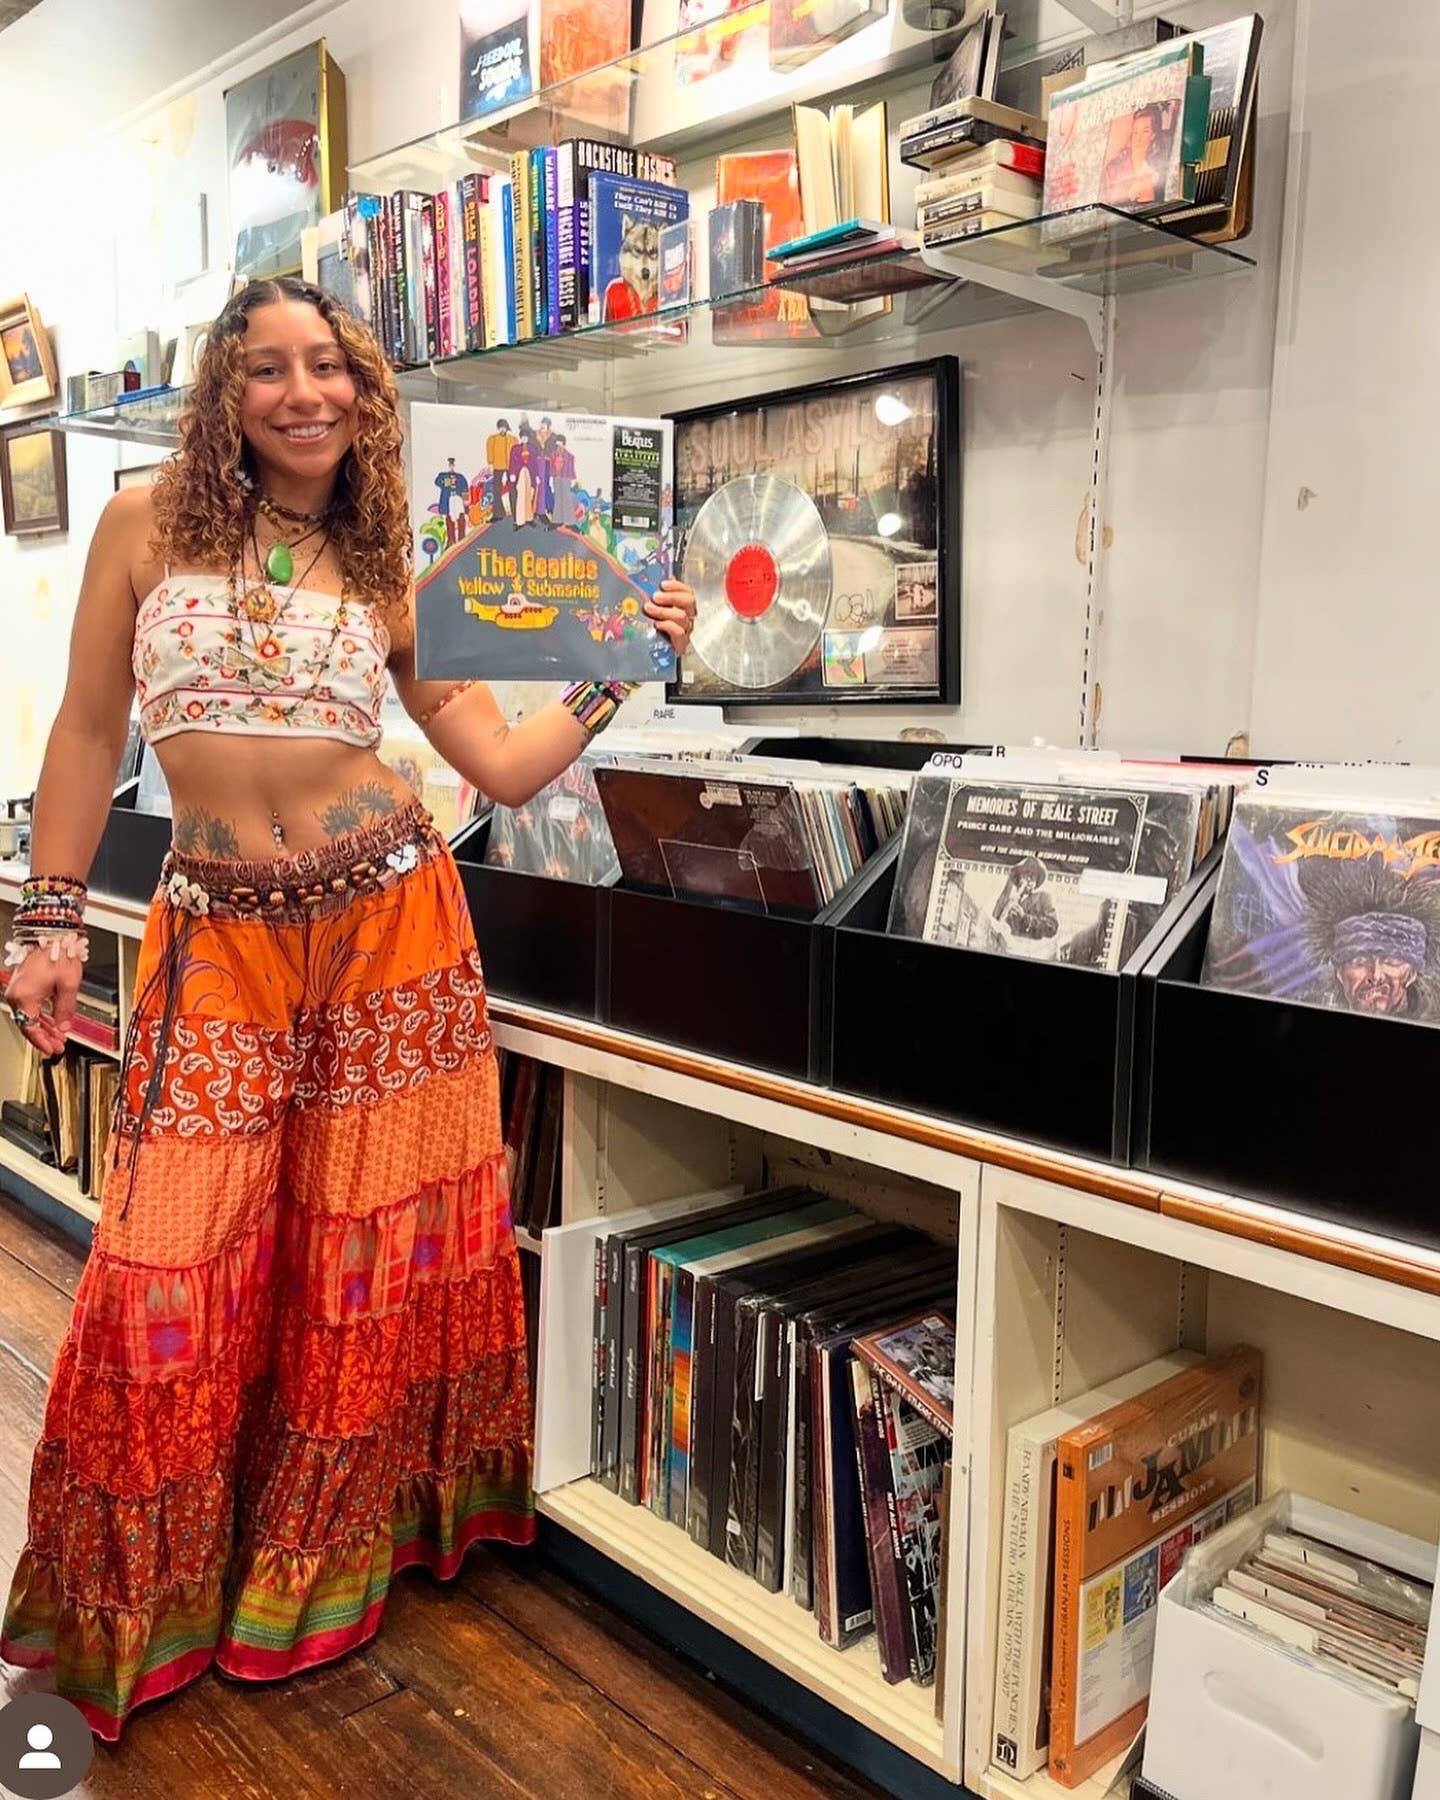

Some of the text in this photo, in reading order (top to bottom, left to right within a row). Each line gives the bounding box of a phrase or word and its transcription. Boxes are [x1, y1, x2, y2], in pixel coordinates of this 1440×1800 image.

[578, 140, 634, 178] BACKSTAGE
[545, 155, 555, 212] WANNABE
[466, 246, 480, 327] LOADED
[690, 411, 777, 473] SOUL
[477, 548, 598, 579] The Beatles
[459, 577, 600, 602] Yellow Submarine
[932, 754, 962, 769] OPQ
[995, 746, 1006, 758] R
[1256, 770, 1269, 786] S
[966, 795, 1019, 817] MEMORIES
[1022, 801, 1039, 818] OF
[1041, 802, 1074, 822] BEALE
[1077, 805, 1119, 827] STREET
[957, 820, 1121, 846] PRINCE GABE AND THE MILLIONAIRES
[1020, 1449, 1032, 1496] RANDY
[1133, 1427, 1220, 1514] JAM
[886, 1491, 897, 1514] NEW
[1017, 1497, 1029, 1560] NEWMAN
[1061, 1518, 1072, 1571] SESSIONS
